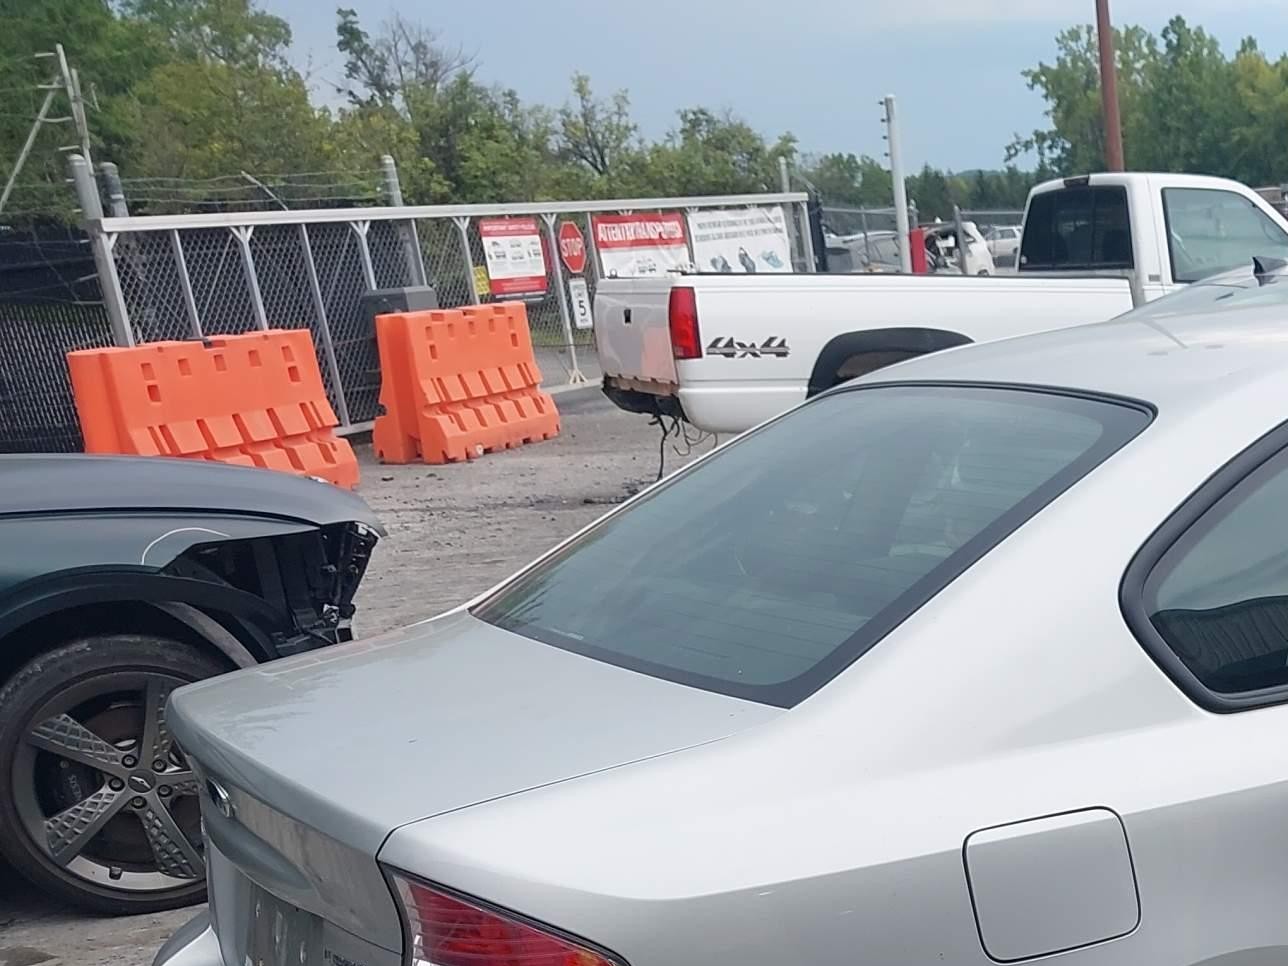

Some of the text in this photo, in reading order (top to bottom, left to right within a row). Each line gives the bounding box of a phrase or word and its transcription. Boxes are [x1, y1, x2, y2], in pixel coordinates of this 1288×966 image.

[561, 237, 583, 257] STOP
[578, 300, 587, 317] 5
[705, 336, 791, 358] 4x4
